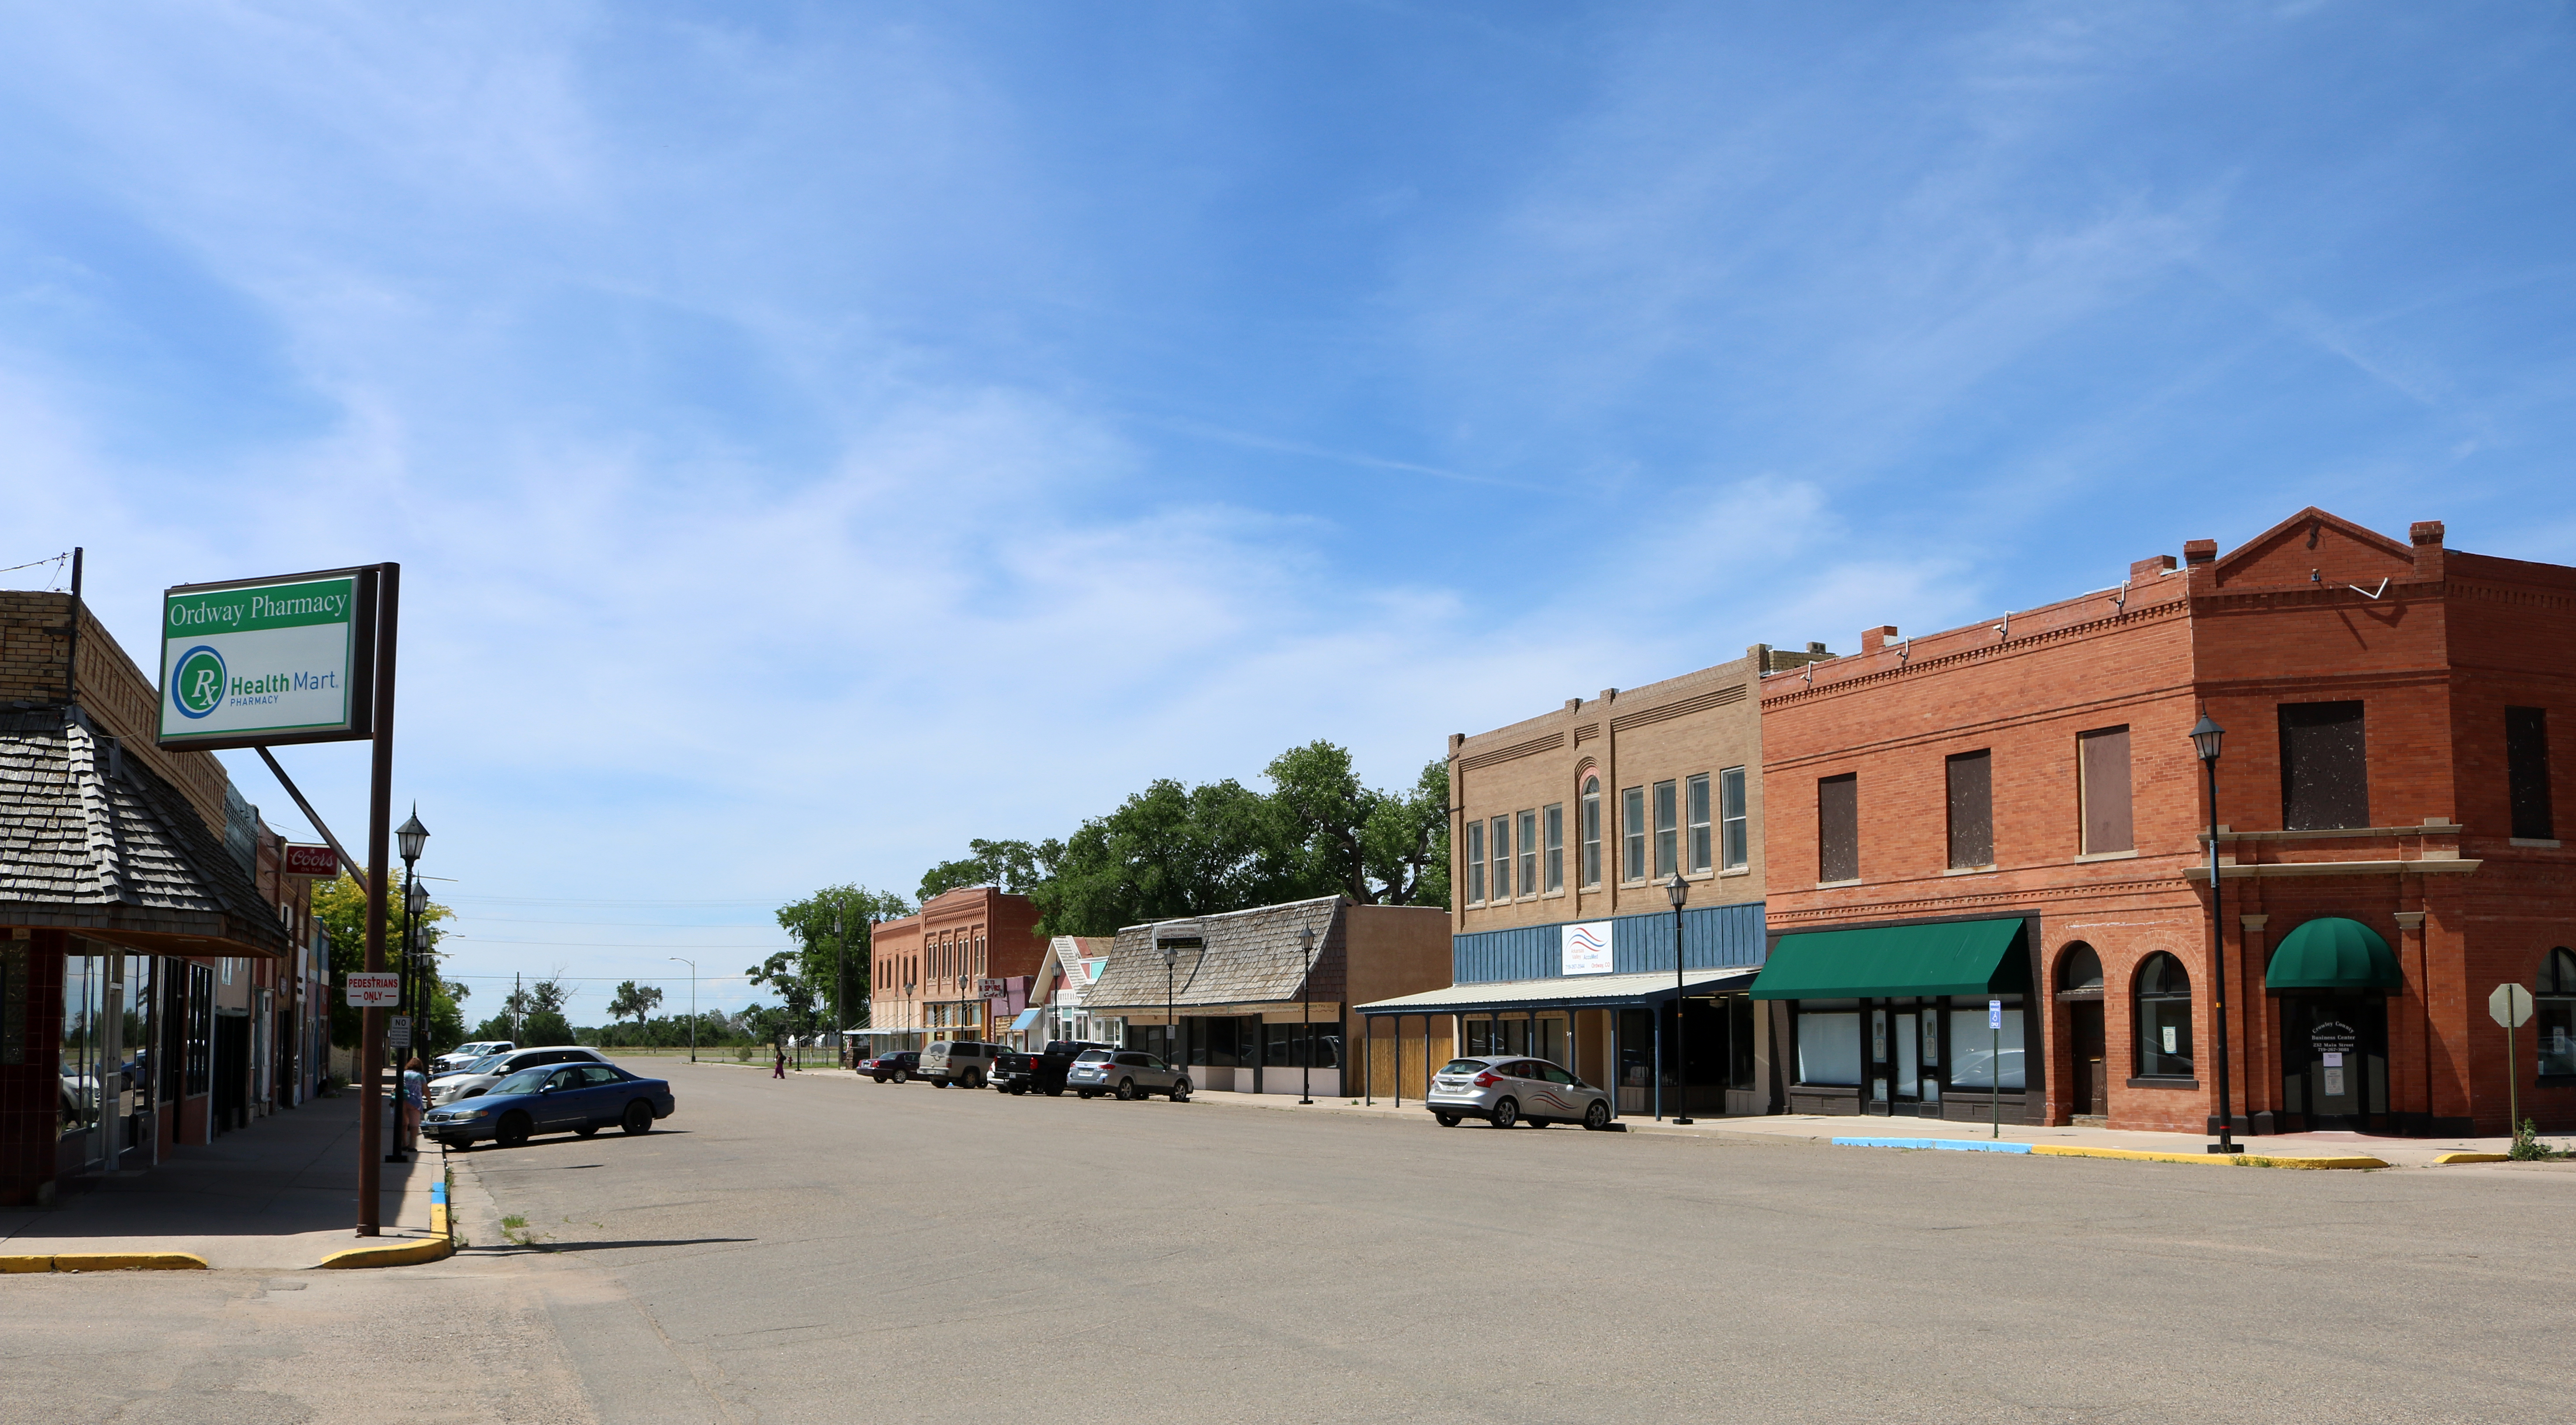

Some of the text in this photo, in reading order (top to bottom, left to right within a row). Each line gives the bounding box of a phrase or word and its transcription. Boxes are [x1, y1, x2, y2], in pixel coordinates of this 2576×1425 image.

[170, 594, 348, 626] Ordway Pharmacy
[231, 673, 289, 695] Health
[230, 695, 279, 707] PHARMACY
[290, 850, 334, 867] Coors
[349, 979, 398, 988] PEDESTRIANS
[363, 991, 383, 1000] ONLY
[2312, 1021, 2355, 1034] Crowley County
